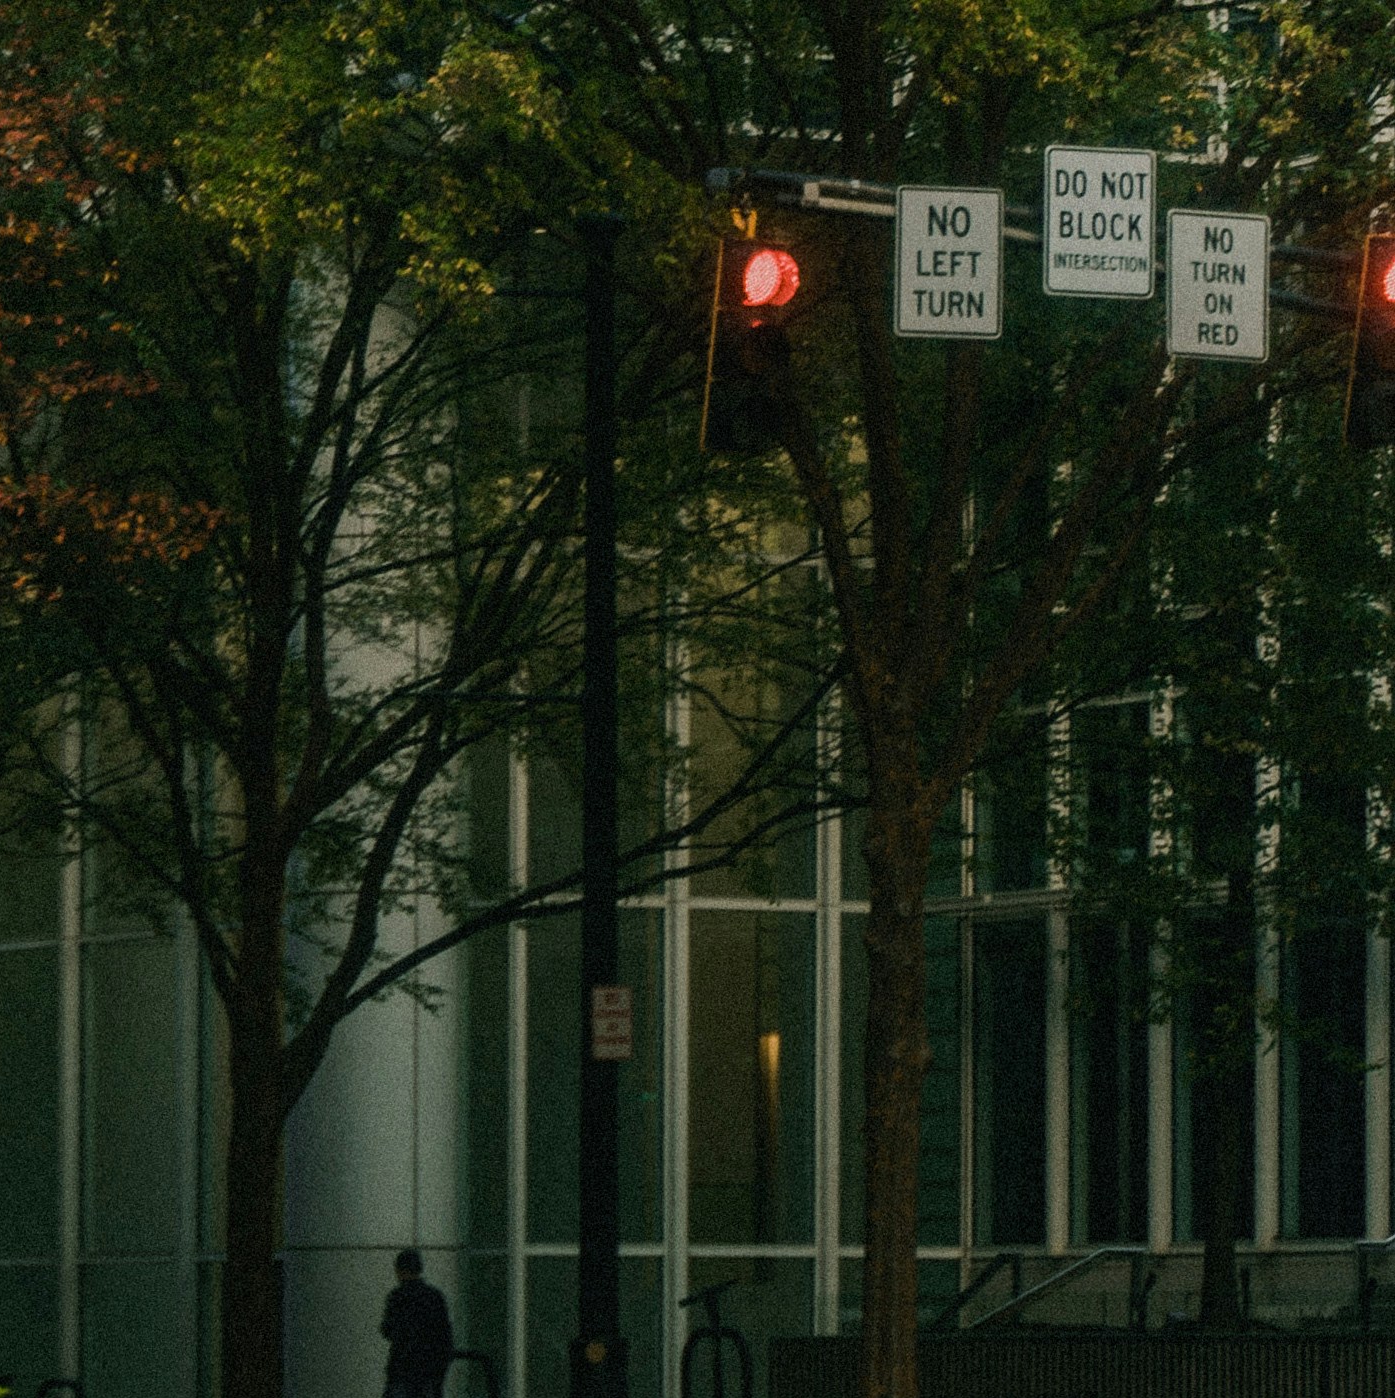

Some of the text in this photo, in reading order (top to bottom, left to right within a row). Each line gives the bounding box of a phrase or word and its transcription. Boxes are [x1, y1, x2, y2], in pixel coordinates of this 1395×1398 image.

[1055, 169, 1148, 200] DO NOT
[927, 205, 971, 238] NO
[1058, 210, 1143, 242] BLOCK
[1203, 226, 1235, 254] NO
[916, 250, 982, 279] LEFT
[1053, 252, 1148, 273] INTERSECTION
[1190, 260, 1247, 285] TURN
[912, 290, 985, 319] TURN
[1204, 293, 1233, 316] ON
[1197, 322, 1239, 347] RED
